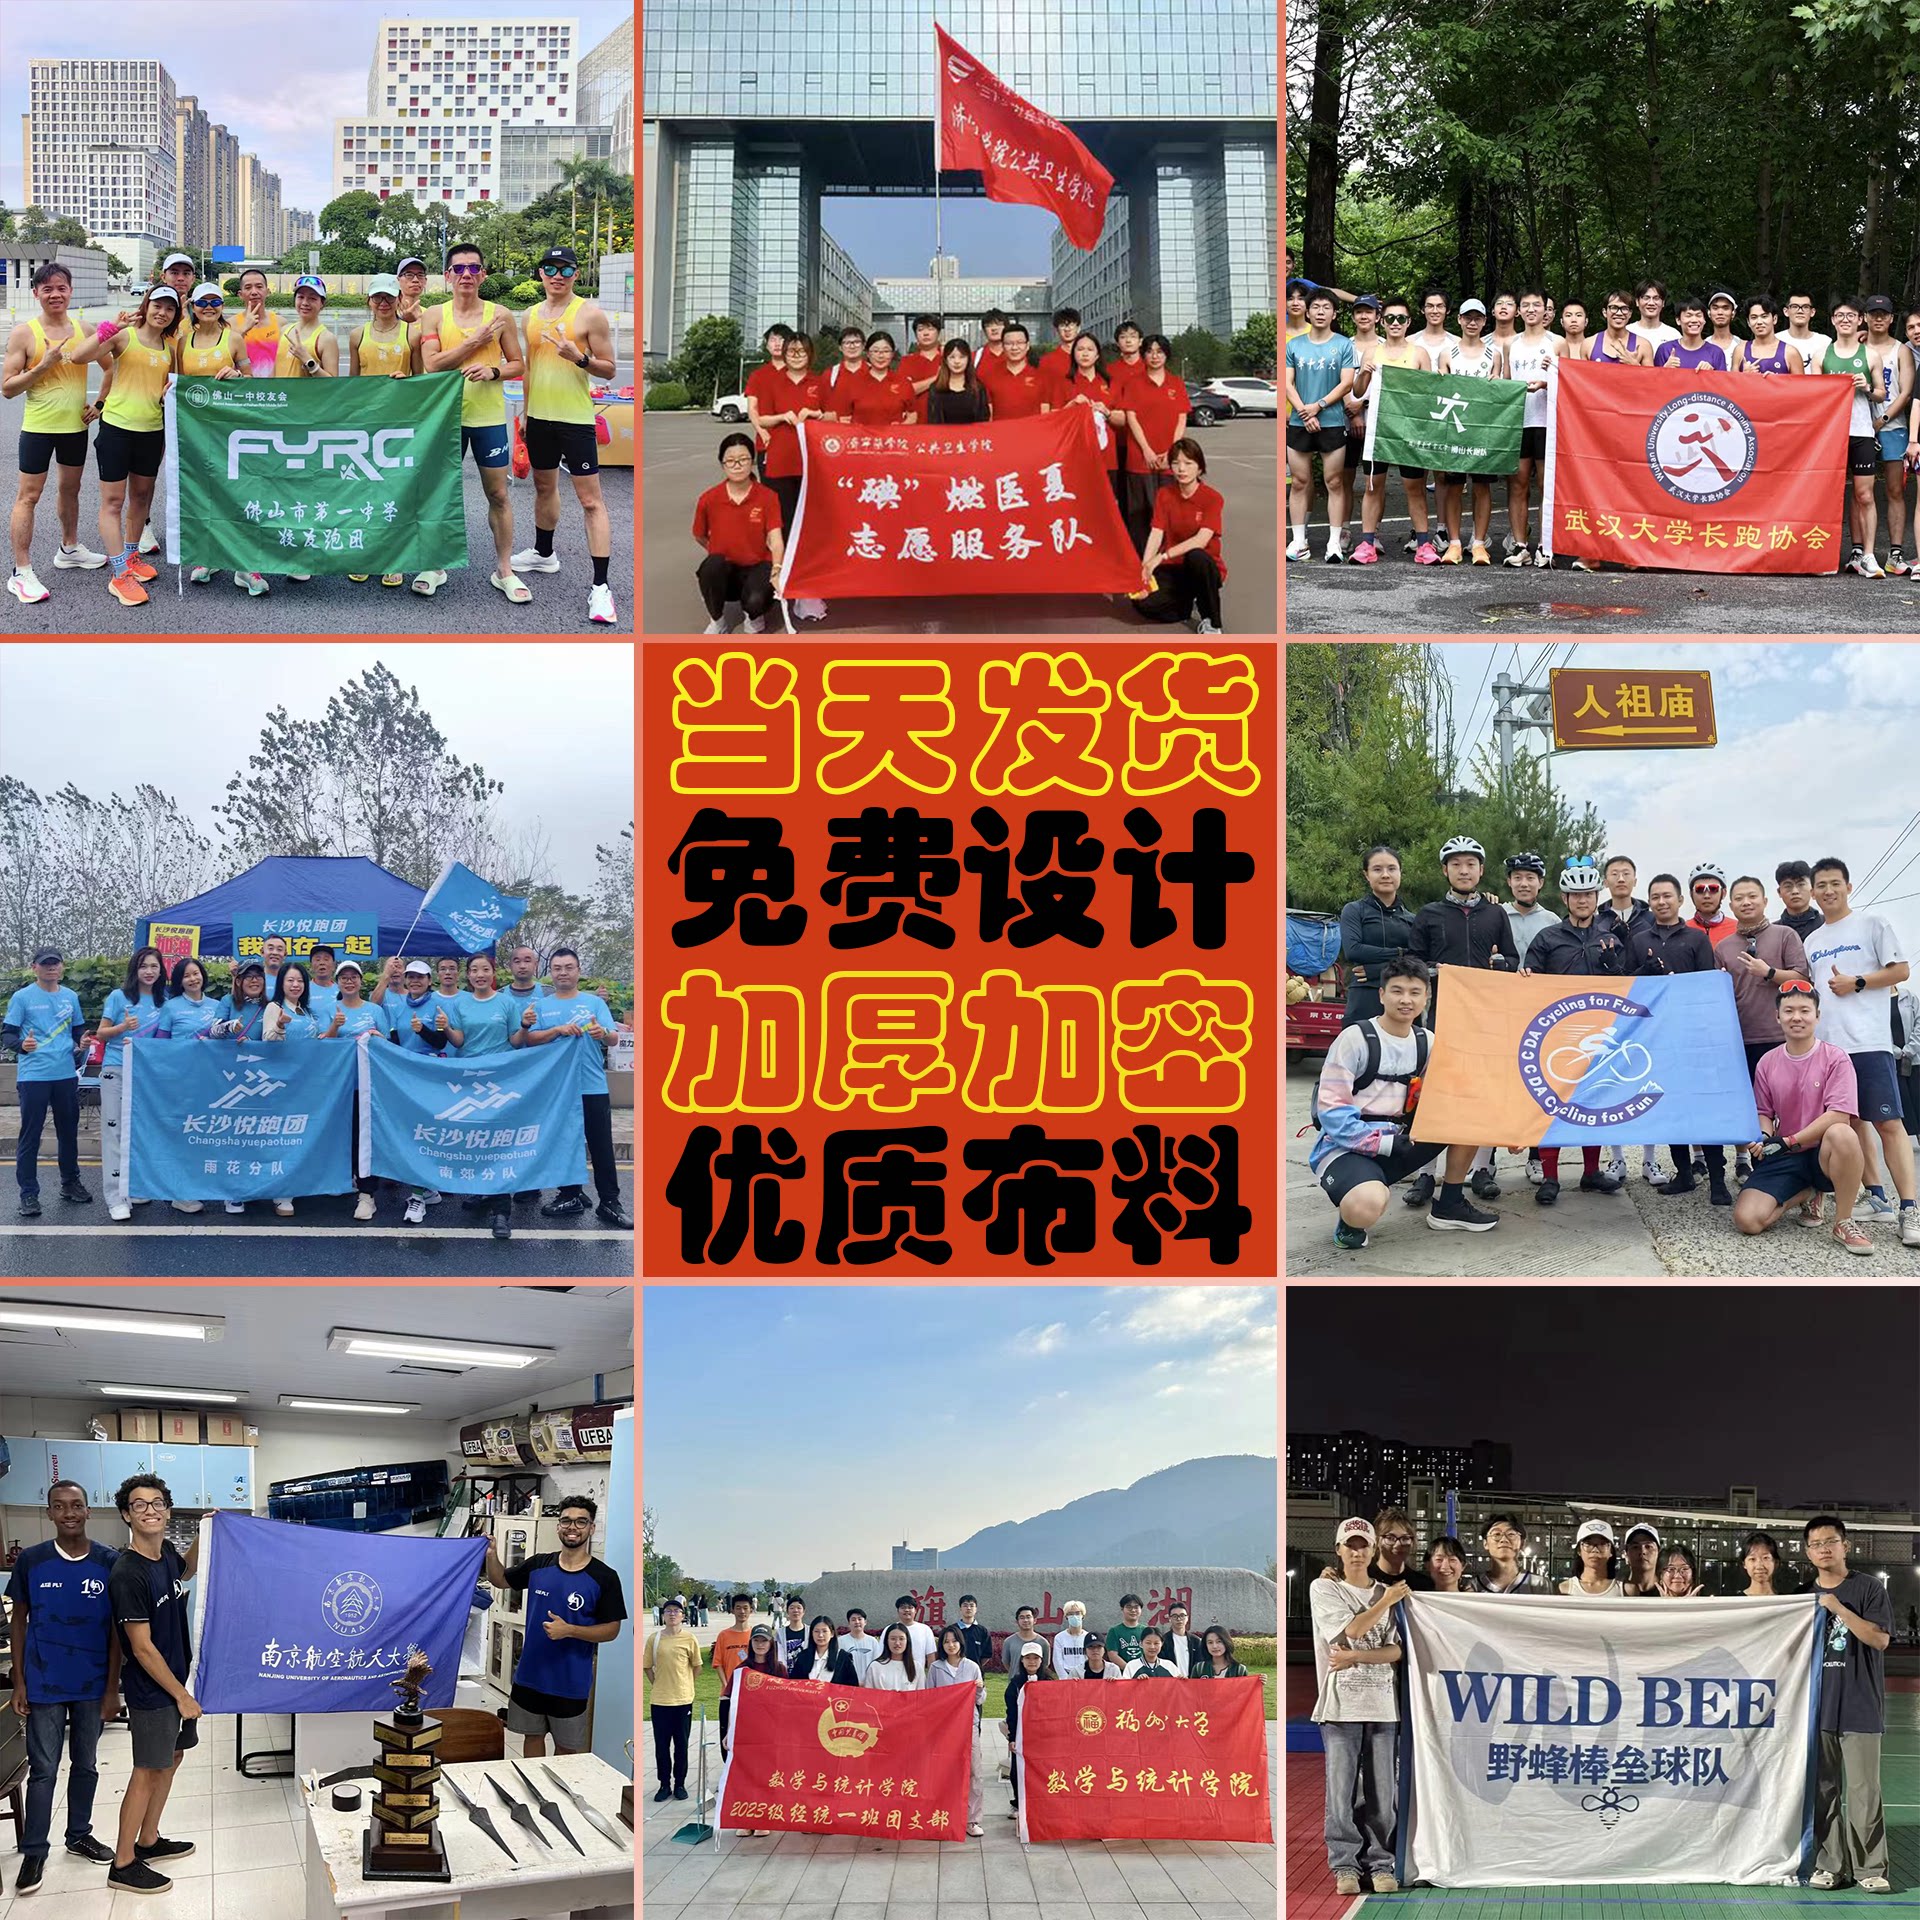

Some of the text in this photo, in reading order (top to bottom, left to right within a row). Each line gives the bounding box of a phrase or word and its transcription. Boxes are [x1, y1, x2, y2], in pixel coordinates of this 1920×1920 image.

[212, 390, 287, 402] 佛山一中校友会
[1647, 393, 1756, 483] Wuhan University Long-distance Running Association
[1668, 486, 1731, 503] 武汉大学长跑协会
[243, 500, 398, 523] 佛山市第一中学
[278, 527, 364, 550] 校友跑团
[846, 517, 1093, 563] 志愿服务队
[1565, 508, 1831, 550] 武汉大学长跑协会
[1573, 683, 1694, 719] 人祖庙
[155, 926, 194, 934] 长沙悦跑团
[262, 919, 348, 933] 长沙悦跑团
[155, 934, 194, 956] 加油
[1538, 998, 1586, 1027] Cycling
[1589, 995, 1609, 1007] for
[1613, 998, 1637, 1015] Fun
[1544, 1096, 1597, 1126] Cycling
[1601, 1111, 1624, 1123] for
[1625, 1096, 1654, 1117] Fun
[183, 1114, 309, 1135] 长沙悦跑团
[413, 1123, 540, 1149] 长沙悦跑团
[188, 1136, 303, 1148] Changsha yuepaotuan
[419, 1146, 537, 1163] Changsha yuepaotuan
[204, 1160, 284, 1176] 雨花分队
[439, 1166, 517, 1180] 南郊分队
[464, 1441, 482, 1454] UFBA
[580, 1429, 613, 1445] UFBA
[332, 1622, 366, 1634] NUAA
[258, 1672, 285, 1680] NANJING
[1438, 1669, 1623, 1726] WILD
[1636, 1676, 1776, 1729] BEE
[1115, 1708, 1210, 1737] 福州大学
[1487, 1742, 1730, 1787] 野蜂棒垒球队
[768, 1769, 919, 1798] 数学与统计学院
[1047, 1764, 1260, 1798] 数学与统计学院
[729, 1801, 951, 1832] 2023级经统一班团支部
